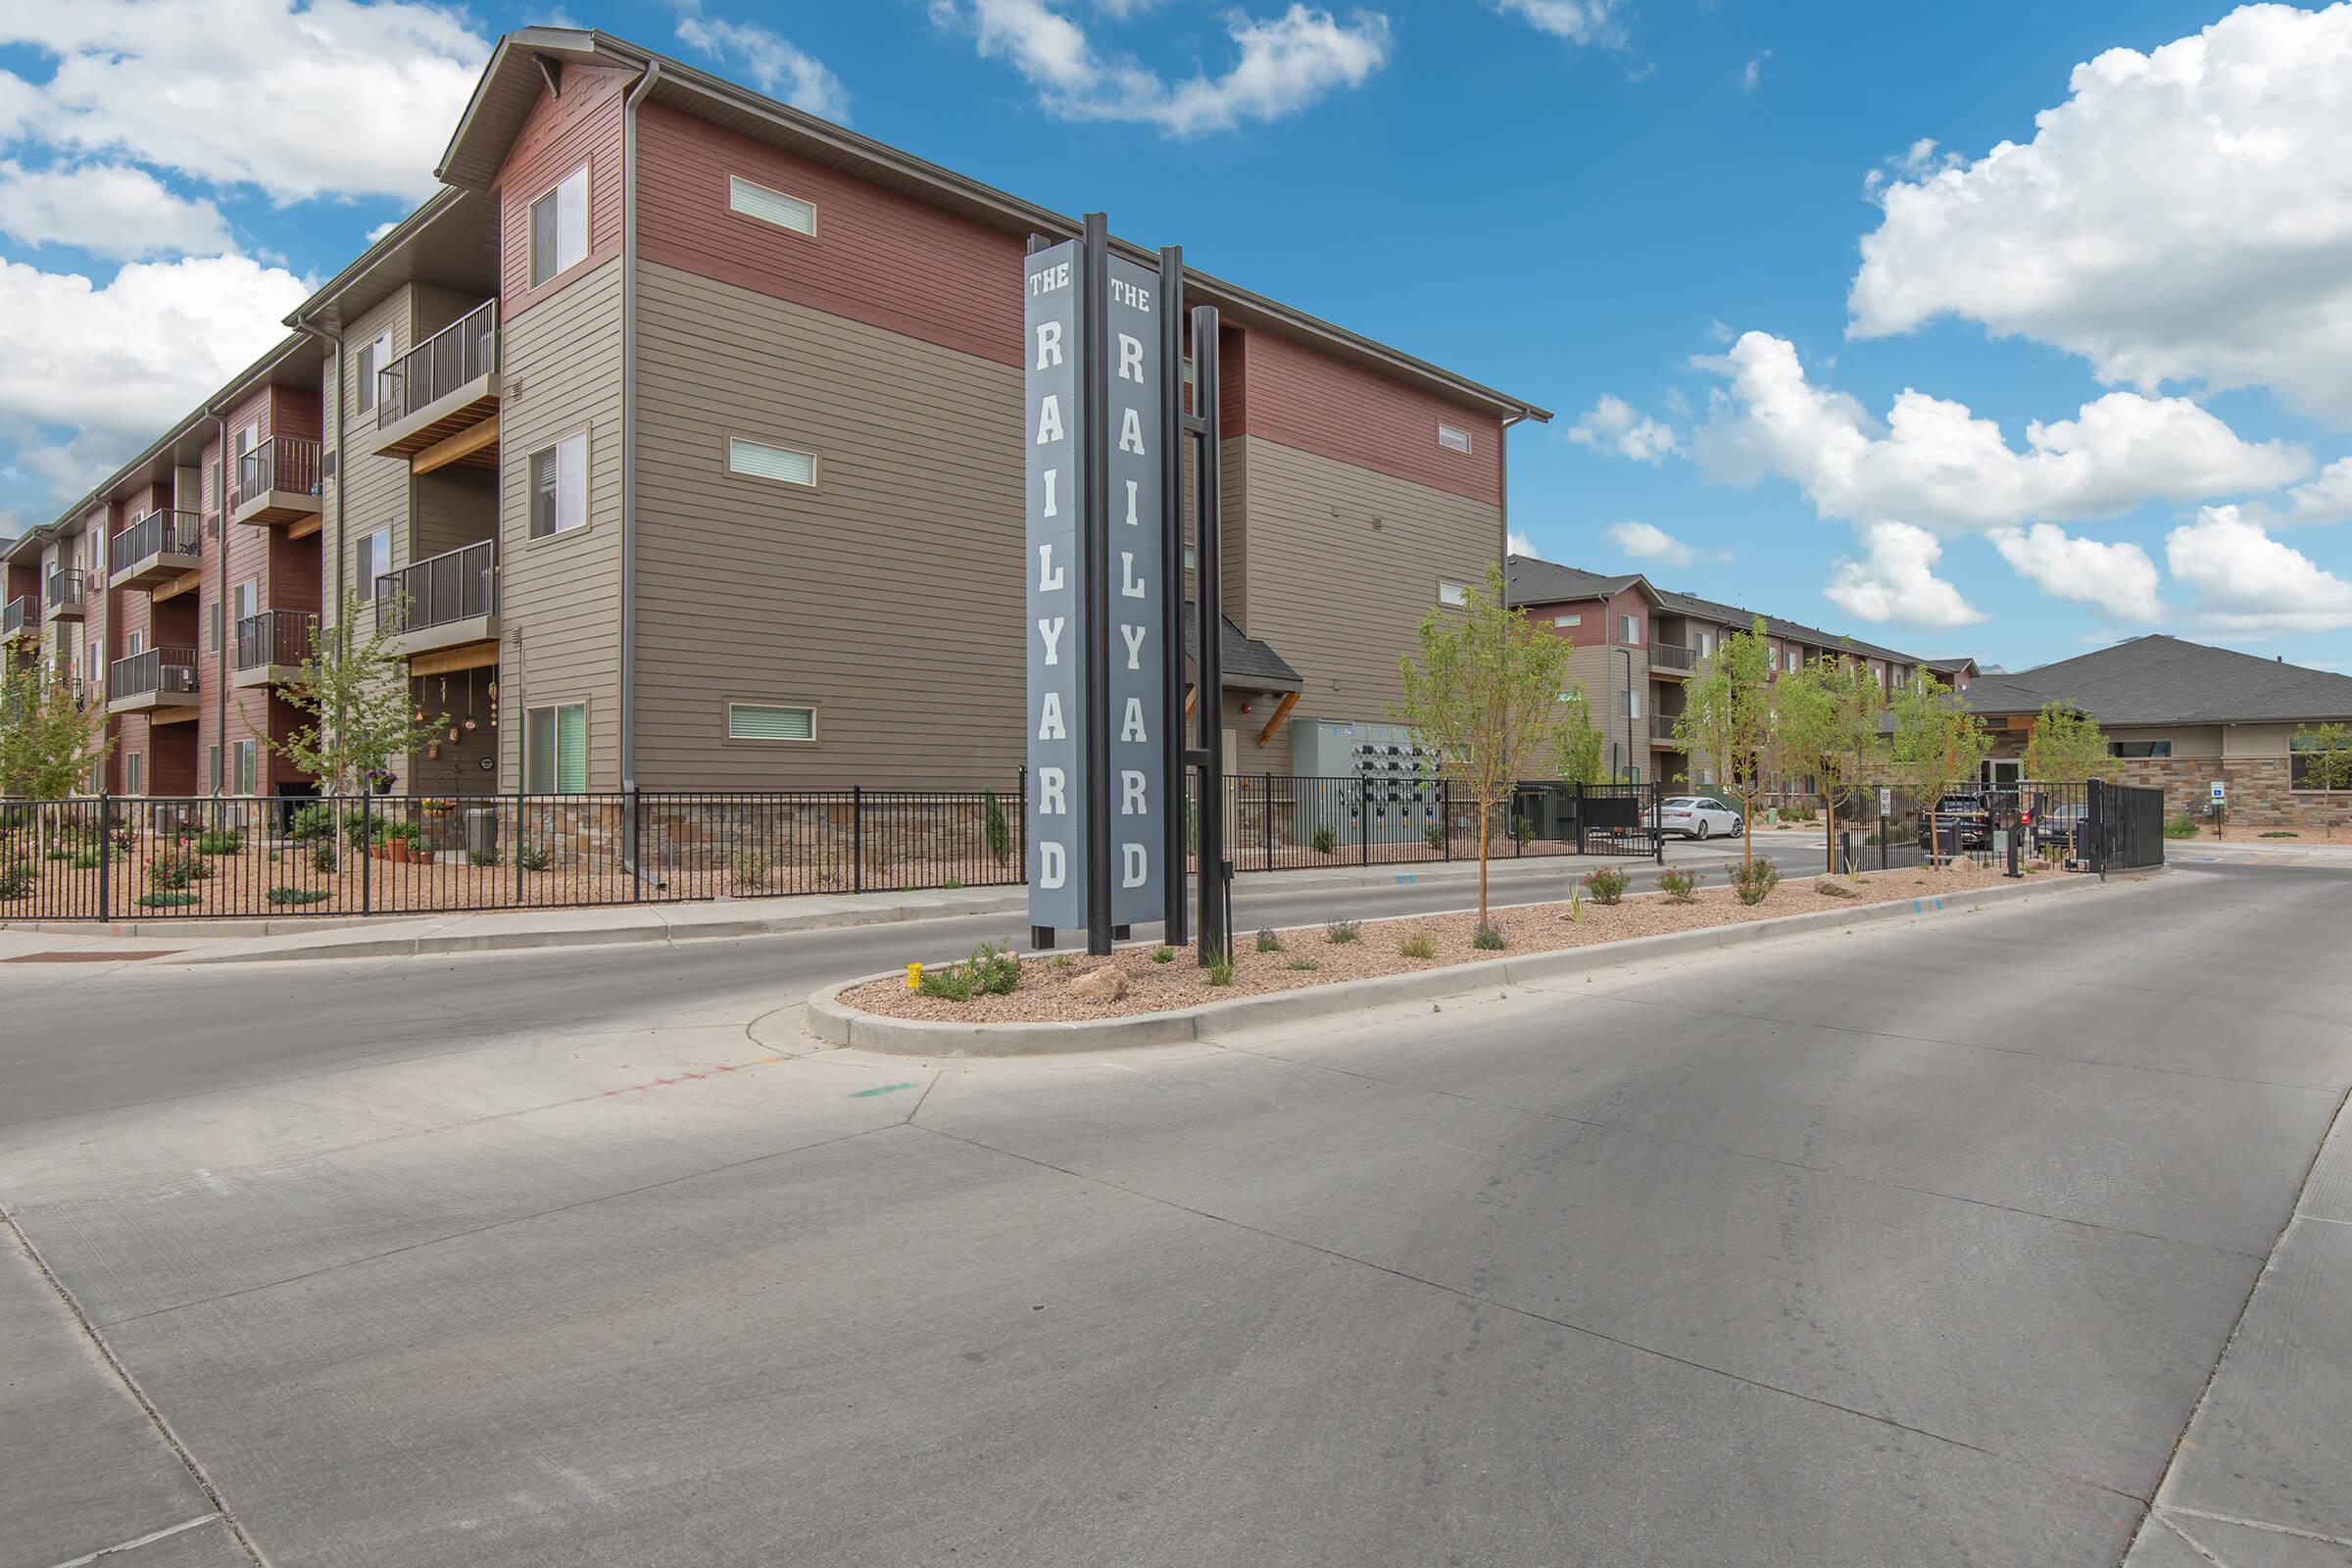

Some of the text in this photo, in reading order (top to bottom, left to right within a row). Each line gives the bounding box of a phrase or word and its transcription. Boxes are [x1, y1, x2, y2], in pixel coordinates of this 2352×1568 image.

[1029, 262, 1069, 297] THE
[1110, 277, 1150, 313] THE
[1036, 320, 1066, 889] RAILYARD
[1118, 332, 1147, 888] RAILYARD
